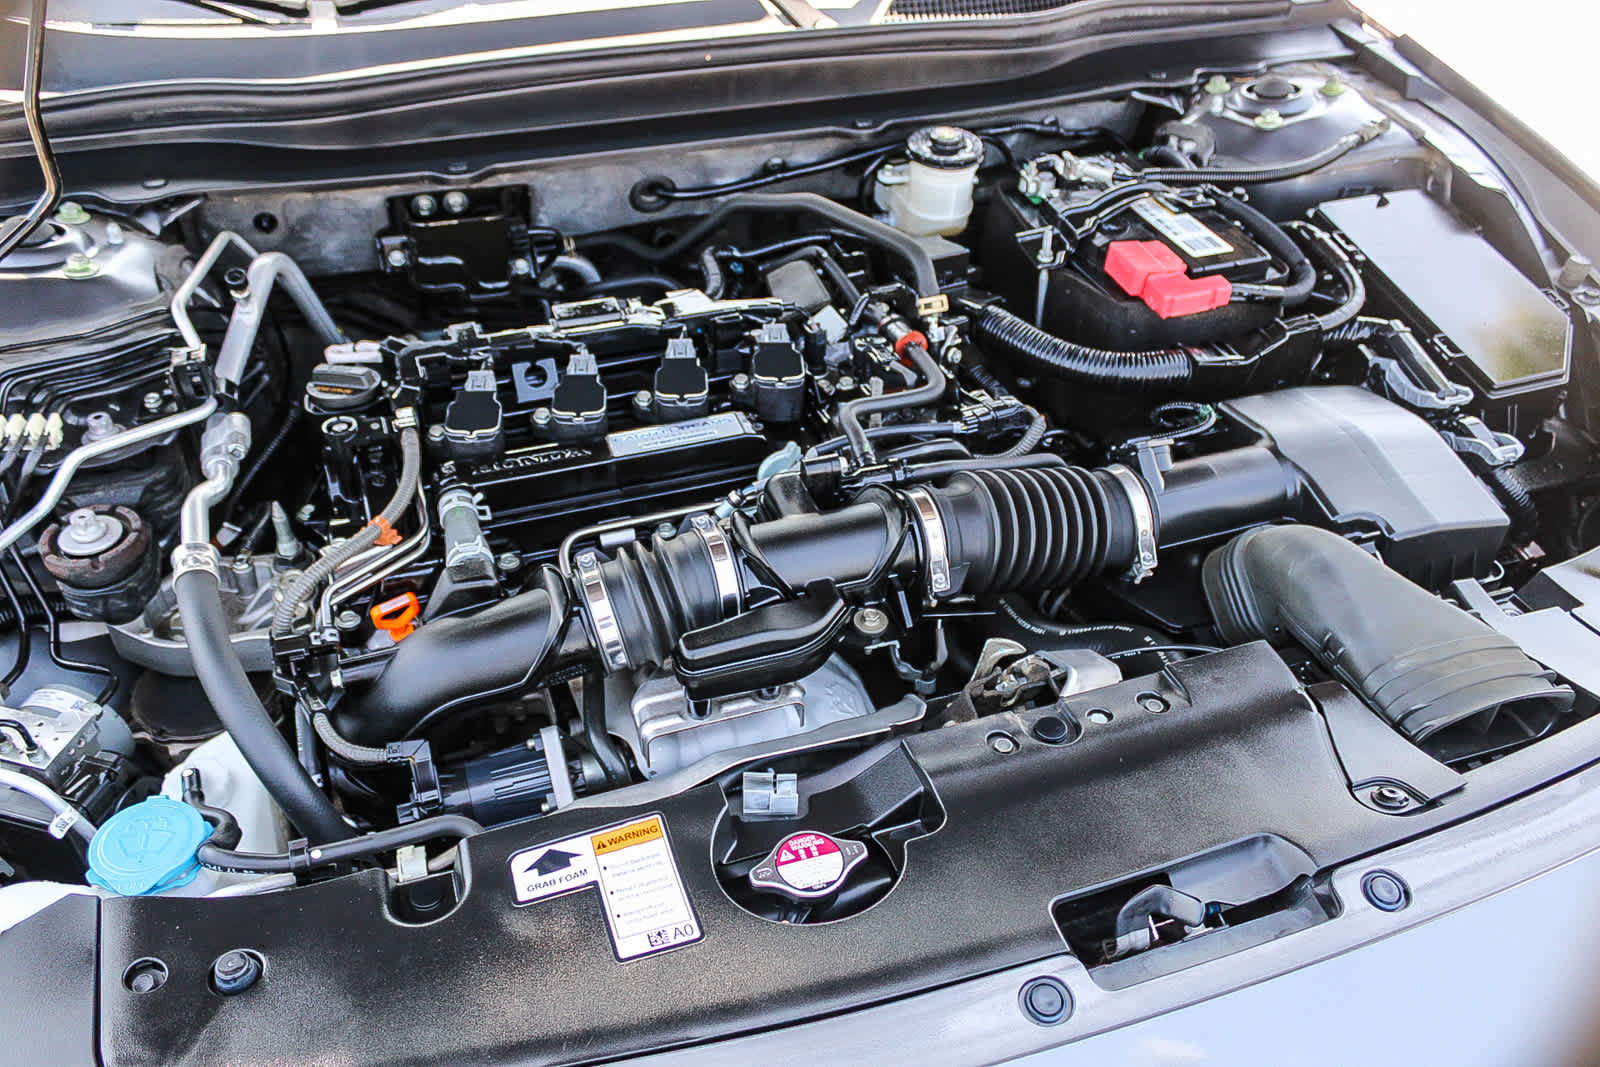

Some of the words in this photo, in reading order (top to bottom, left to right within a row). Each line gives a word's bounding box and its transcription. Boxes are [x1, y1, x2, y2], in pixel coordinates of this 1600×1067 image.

[607, 825, 658, 845] WARNING
[527, 879, 557, 892] GRAB
[558, 868, 588, 883] FOAM
